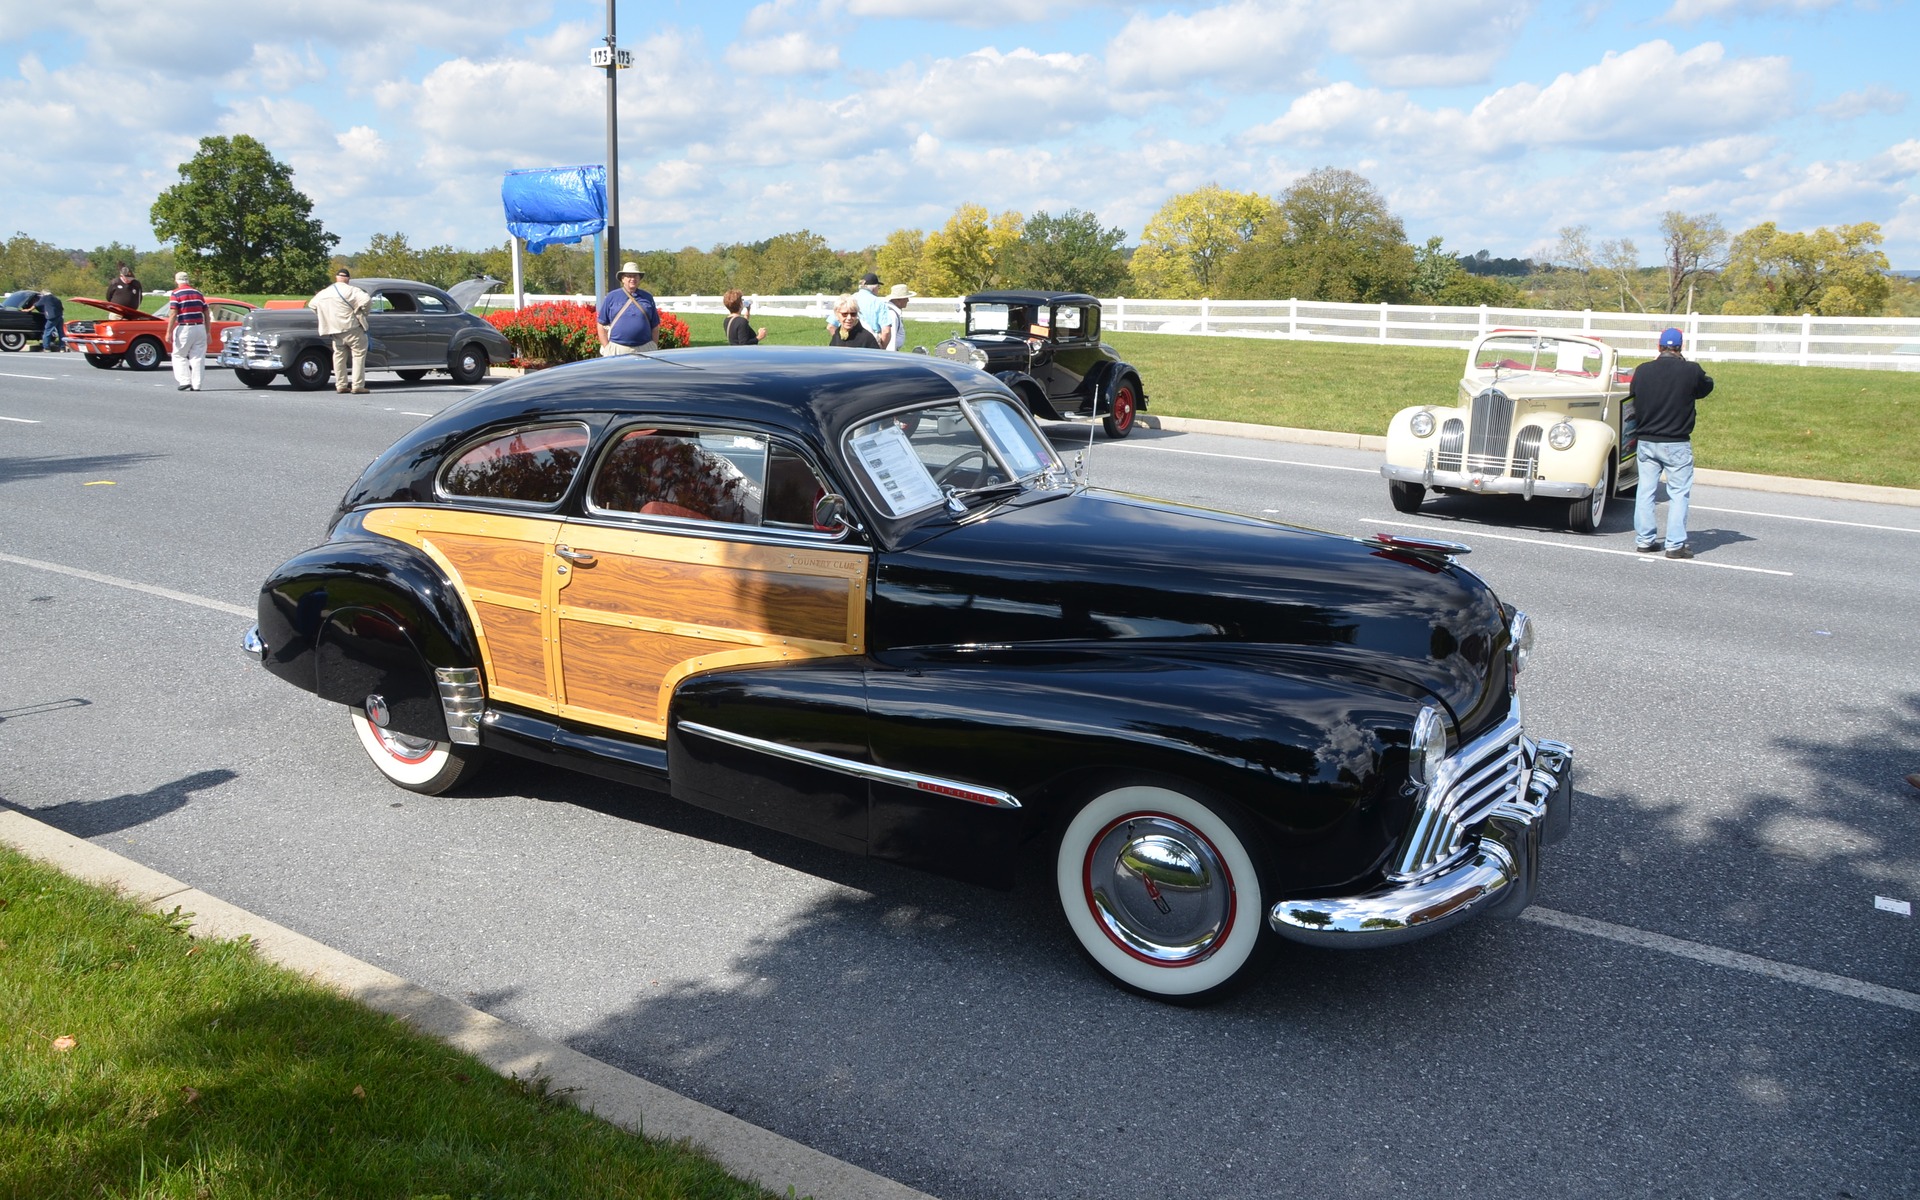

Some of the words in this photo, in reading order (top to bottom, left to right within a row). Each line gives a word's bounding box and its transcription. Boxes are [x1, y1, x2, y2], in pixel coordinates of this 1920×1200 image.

[594, 50, 608, 64] 173
[617, 50, 631, 65] 173
[792, 557, 832, 568] COUNTRY
[833, 561, 855, 570] CLUB
